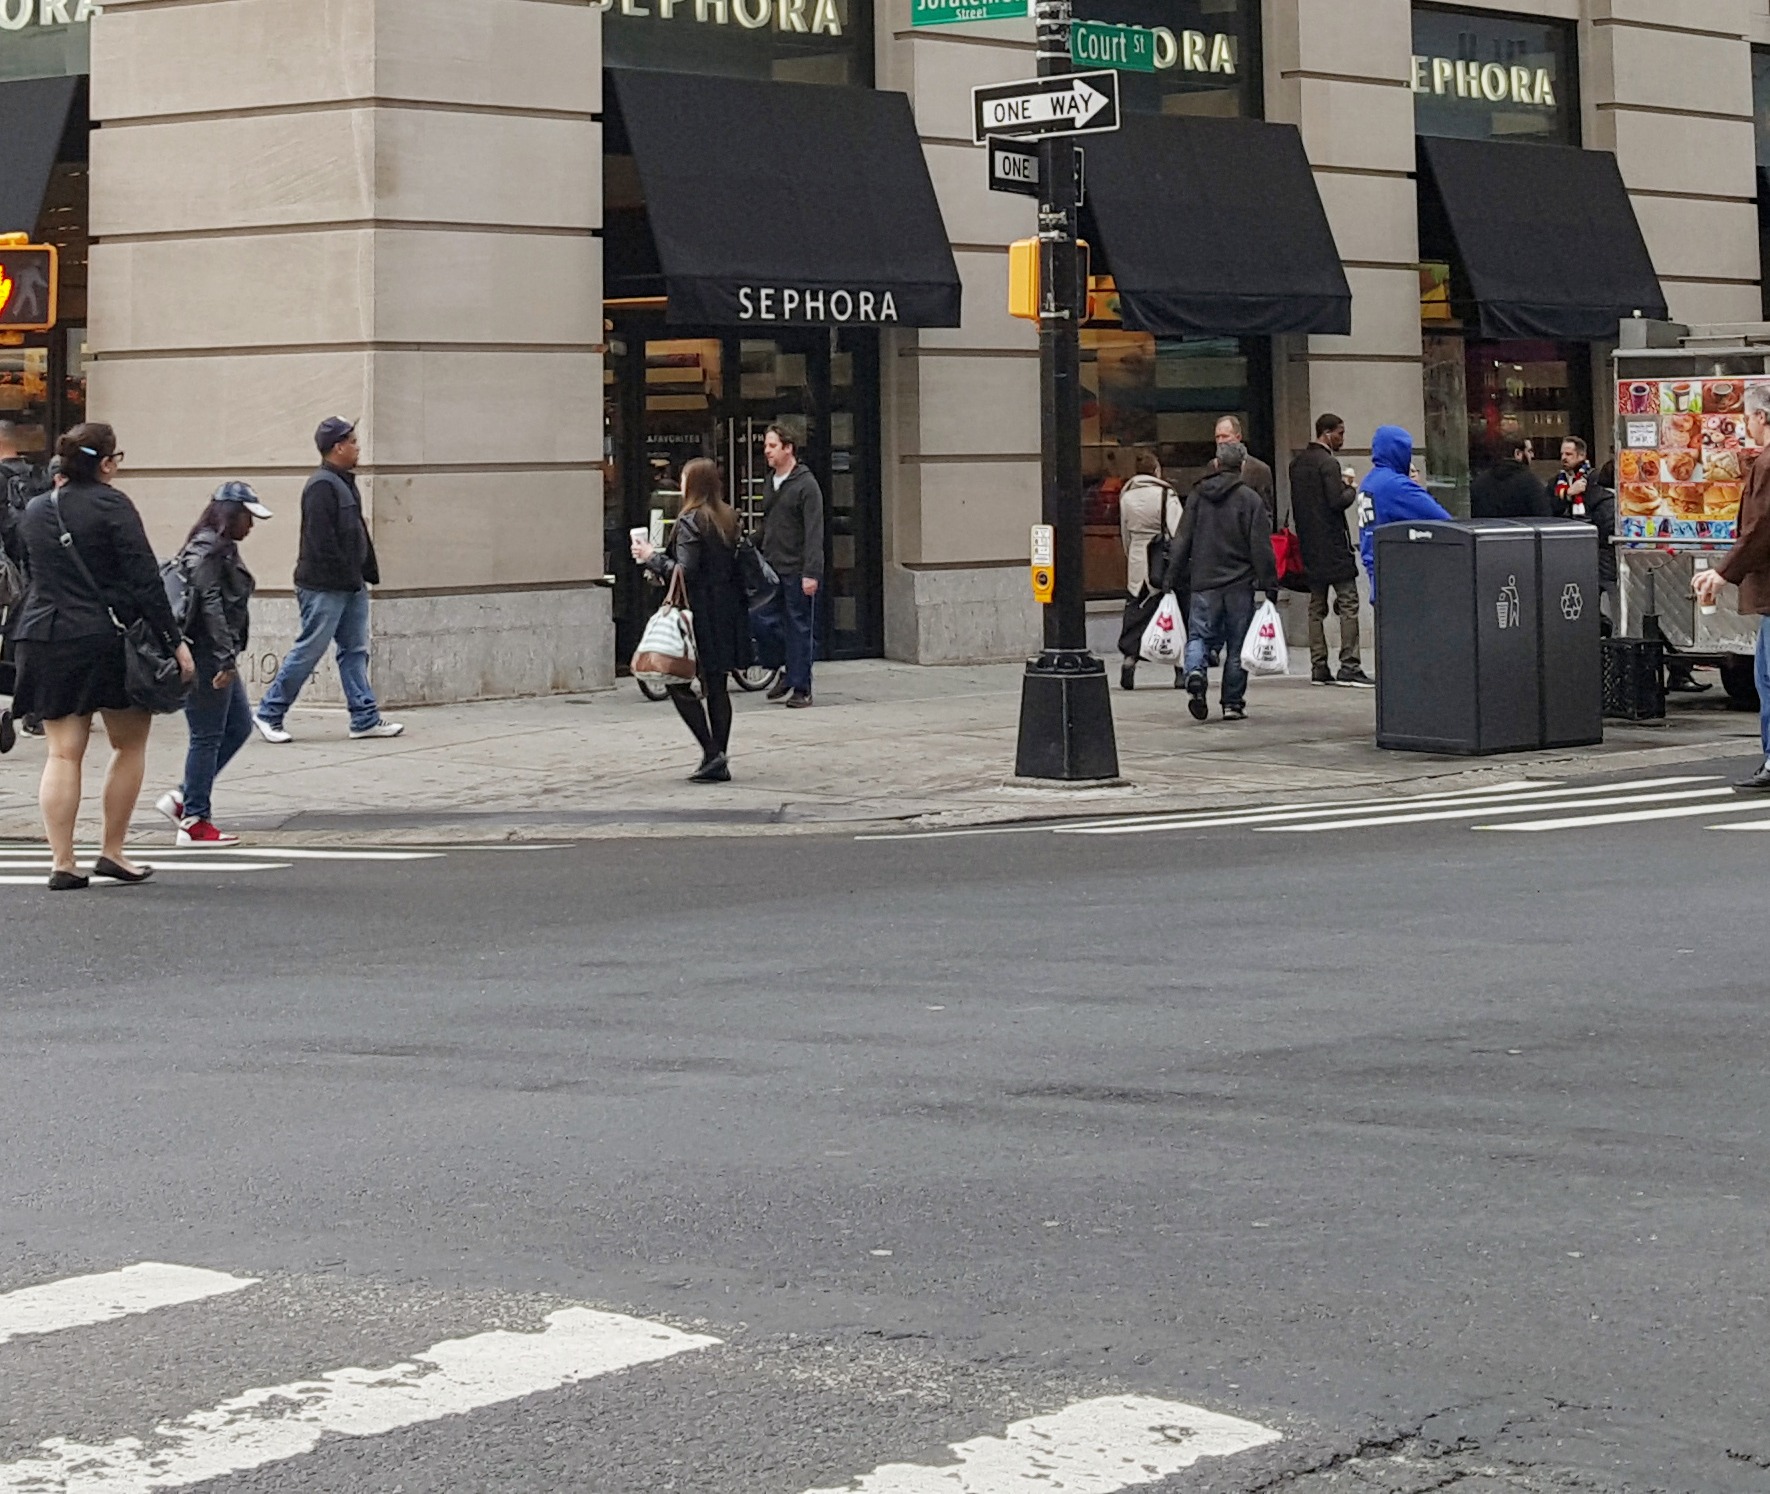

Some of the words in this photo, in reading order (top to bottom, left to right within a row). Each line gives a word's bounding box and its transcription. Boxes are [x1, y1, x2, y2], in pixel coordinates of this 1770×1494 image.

[955, 6, 988, 20] Street
[1076, 29, 1127, 63] Court
[1133, 35, 1146, 54] St
[1409, 55, 1556, 106] EPHORA
[993, 99, 1032, 123] ONE
[1051, 91, 1094, 117] WAY
[1002, 155, 1030, 179] ONE
[739, 286, 898, 321] SEPHORA
